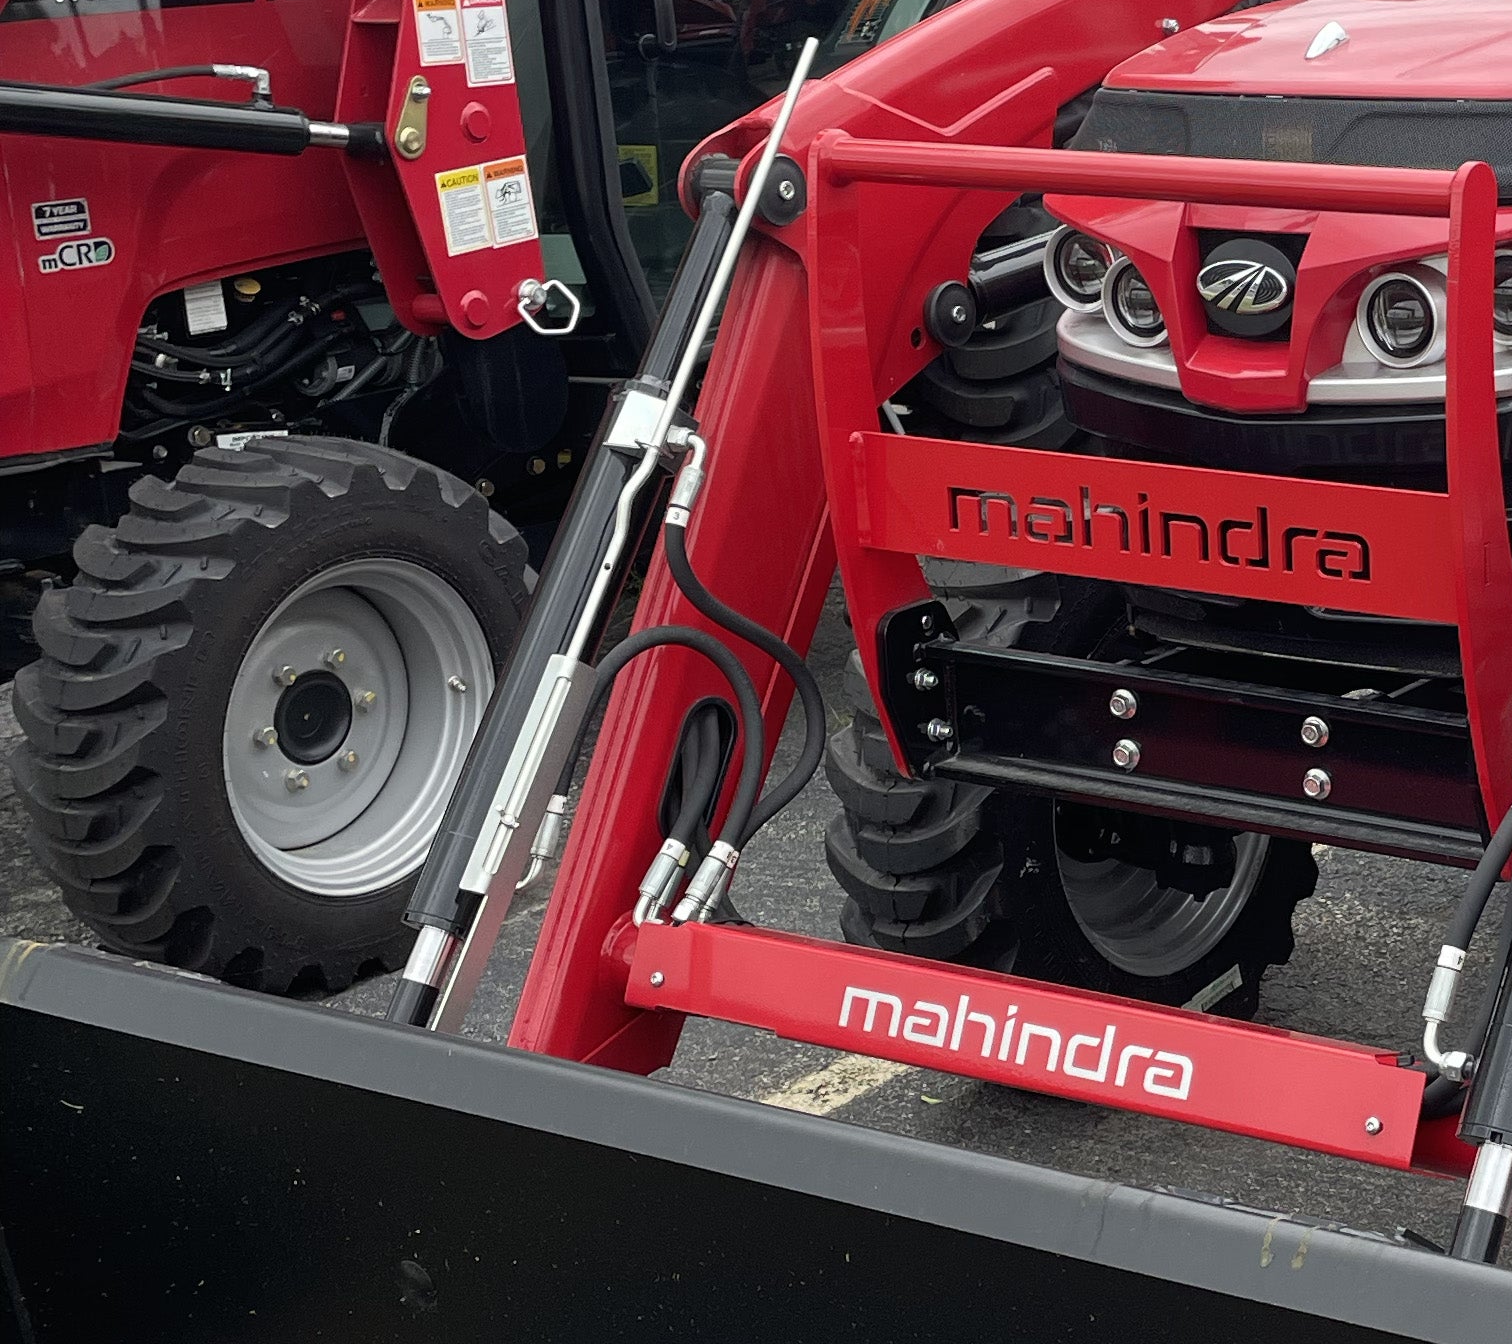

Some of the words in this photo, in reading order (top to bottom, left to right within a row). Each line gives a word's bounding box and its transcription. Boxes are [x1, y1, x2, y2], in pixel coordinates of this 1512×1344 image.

[446, 173, 479, 188] CAUTION
[946, 485, 1372, 584] mahindra
[838, 986, 1194, 1100] mahindra
